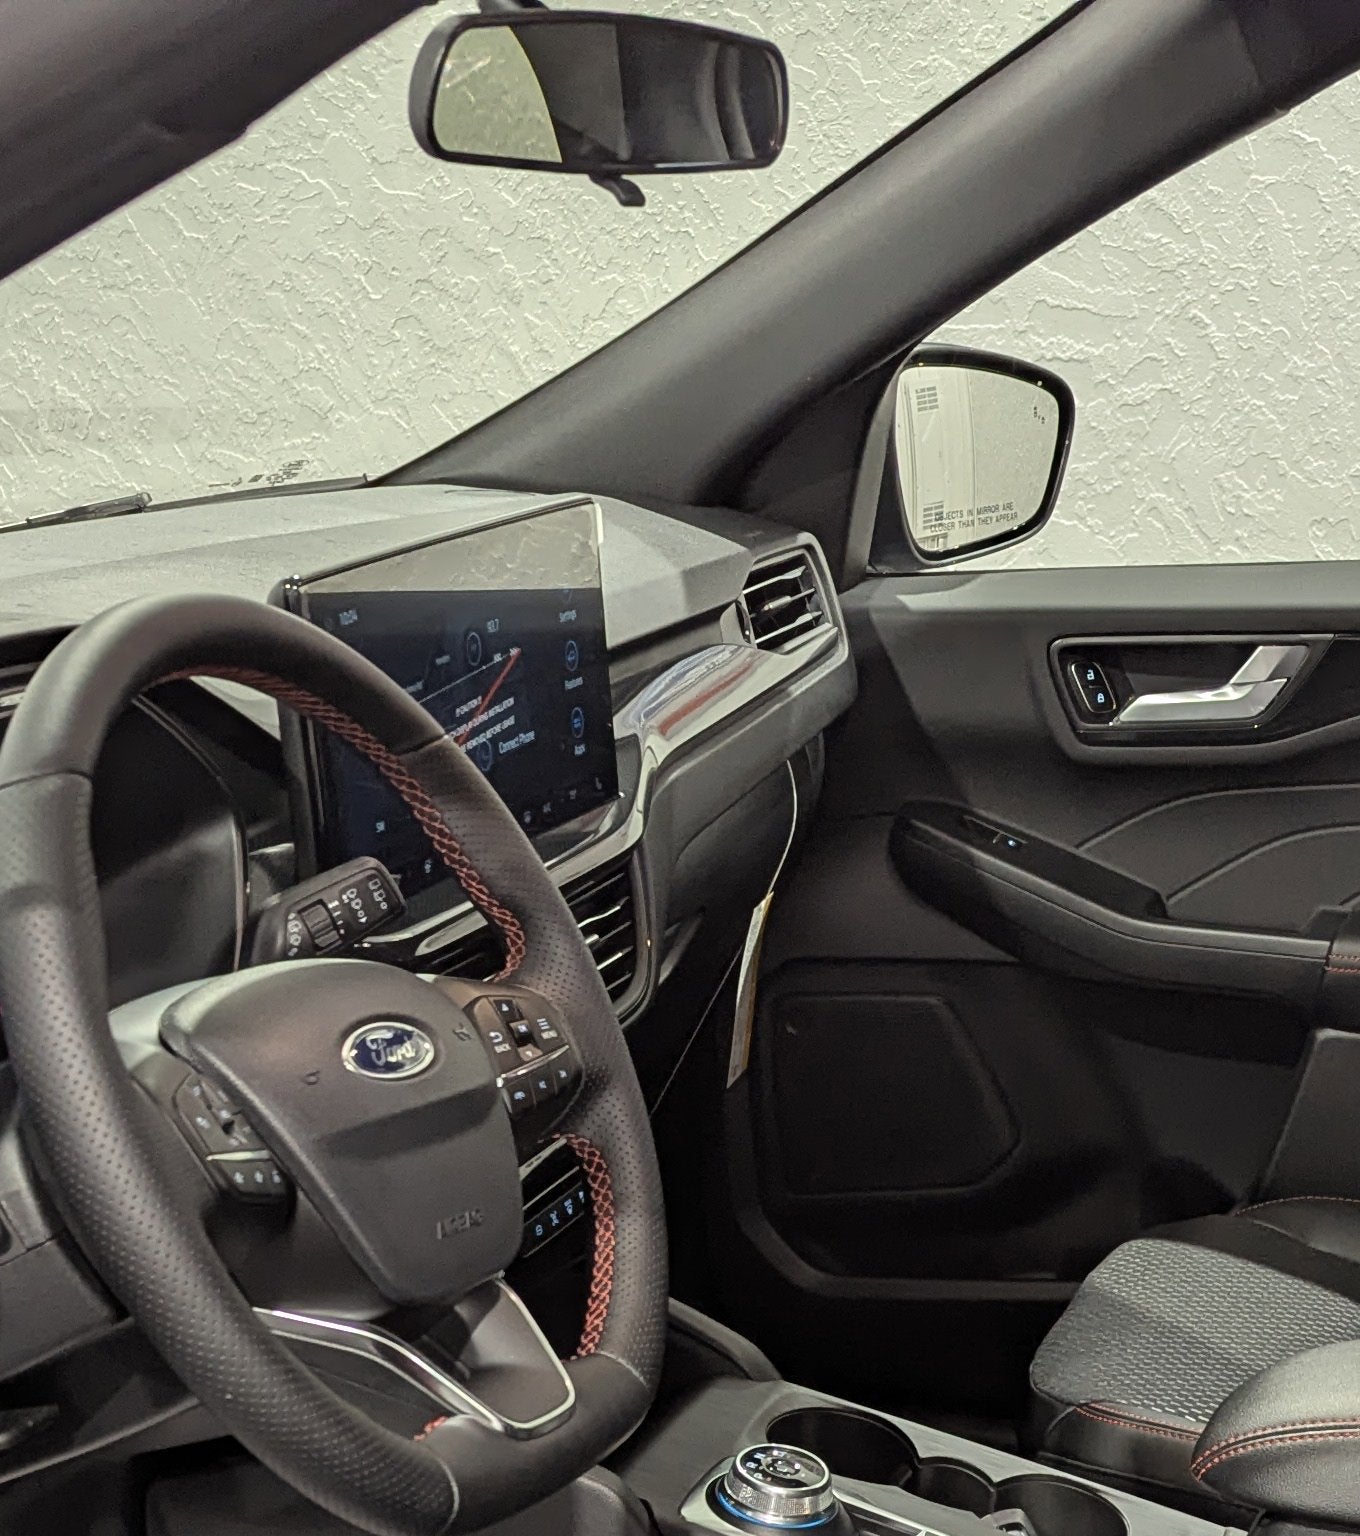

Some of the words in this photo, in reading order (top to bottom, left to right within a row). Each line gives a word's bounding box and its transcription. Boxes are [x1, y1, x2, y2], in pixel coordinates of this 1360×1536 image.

[930, 521, 956, 533] CLOSER
[958, 518, 975, 528] THAN
[977, 515, 993, 526] THEY
[995, 511, 1018, 523] APPEAR
[934, 509, 964, 522] OBJECTS
[967, 508, 974, 517] IN
[976, 504, 1000, 516] MIRROR
[1002, 501, 1014, 512] ARE
[365, 1030, 416, 1066] Ford
